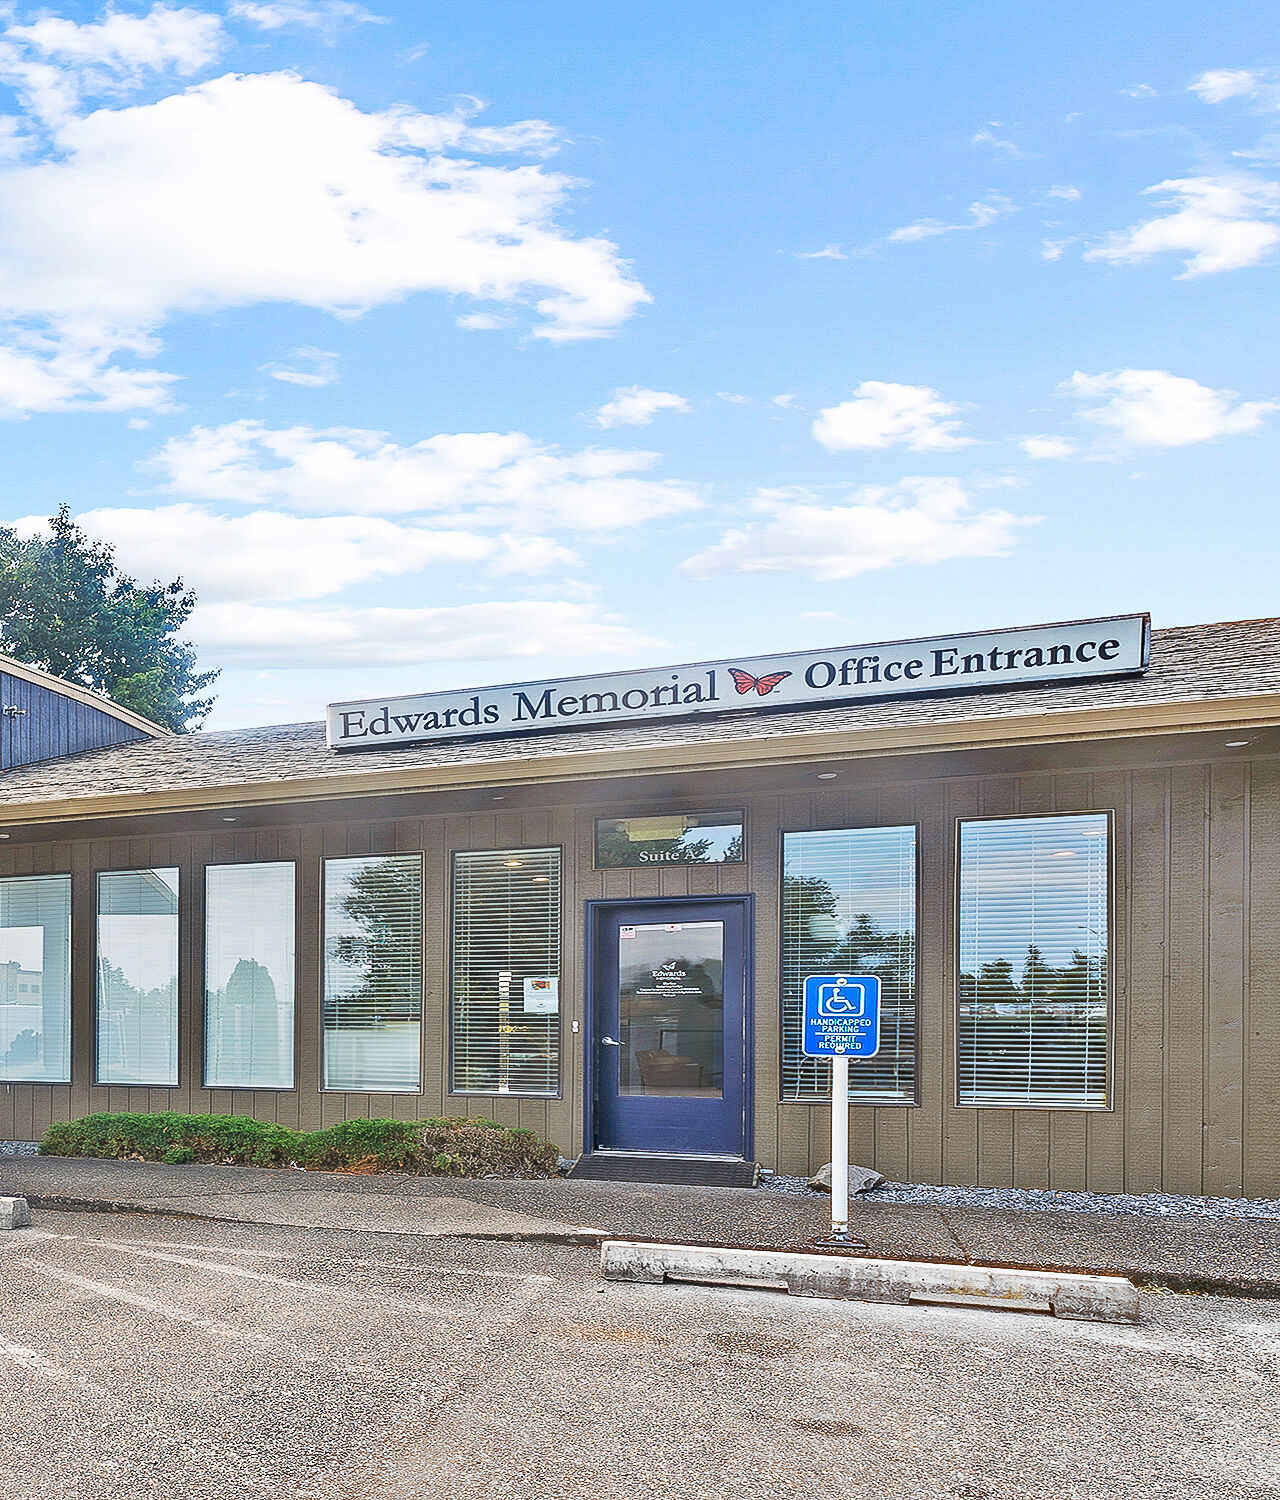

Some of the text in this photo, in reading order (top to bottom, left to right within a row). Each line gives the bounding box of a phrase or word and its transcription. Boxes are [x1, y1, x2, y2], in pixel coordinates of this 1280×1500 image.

[338, 638, 1121, 739] Edwards Memorial Office Entrance
[639, 849, 696, 862] Suite A
